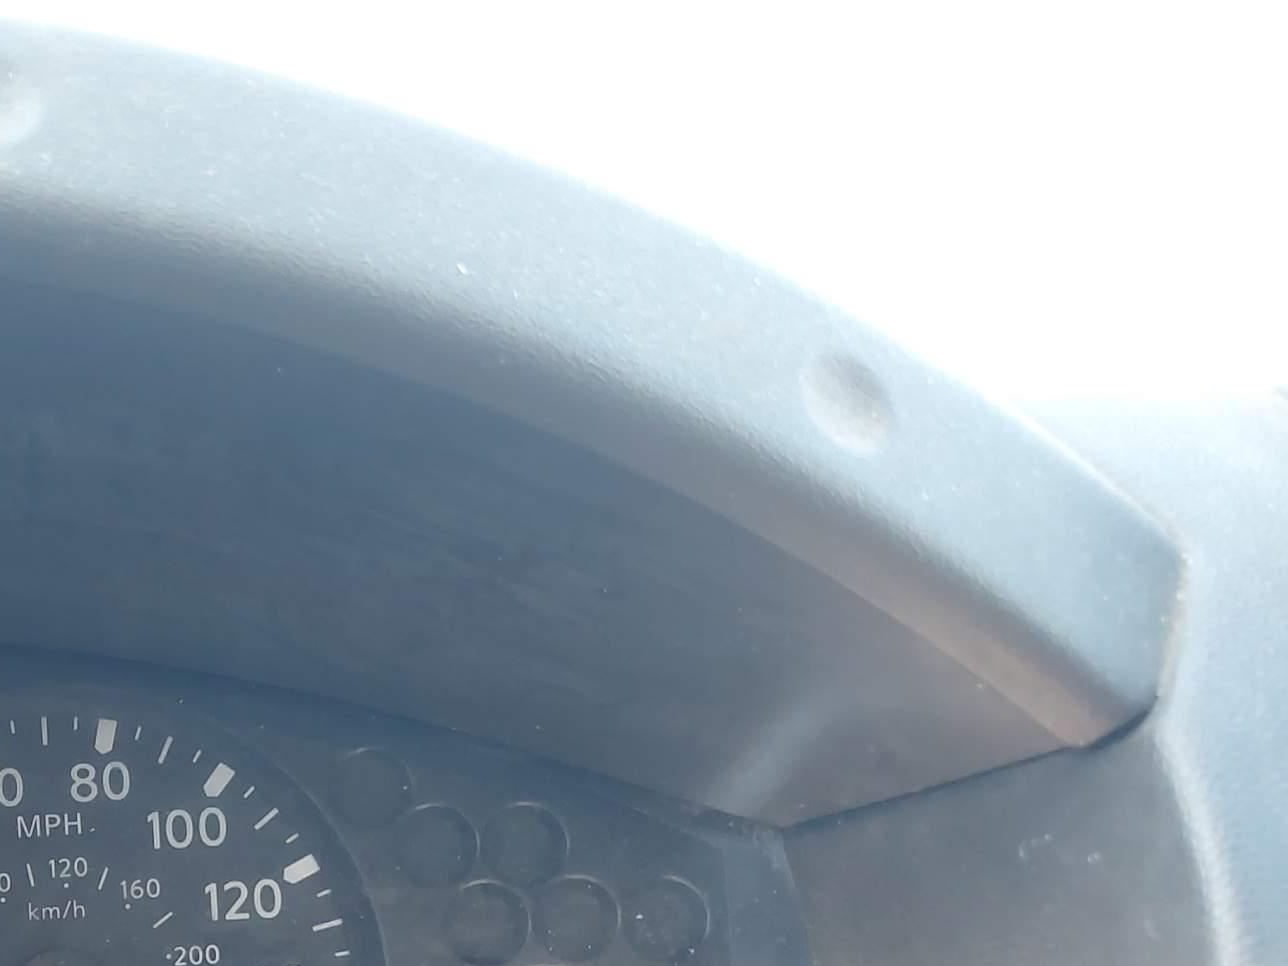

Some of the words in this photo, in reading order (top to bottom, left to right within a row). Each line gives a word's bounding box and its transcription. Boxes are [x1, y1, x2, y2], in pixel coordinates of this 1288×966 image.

[70, 761, 130, 802] 80
[17, 813, 83, 839] MPH
[146, 808, 227, 850] 100
[48, 857, 88, 880] 120
[120, 879, 161, 900] 160
[204, 880, 283, 922] 120
[27, 901, 86, 921] km/h
[173, 945, 220, 966] 200
